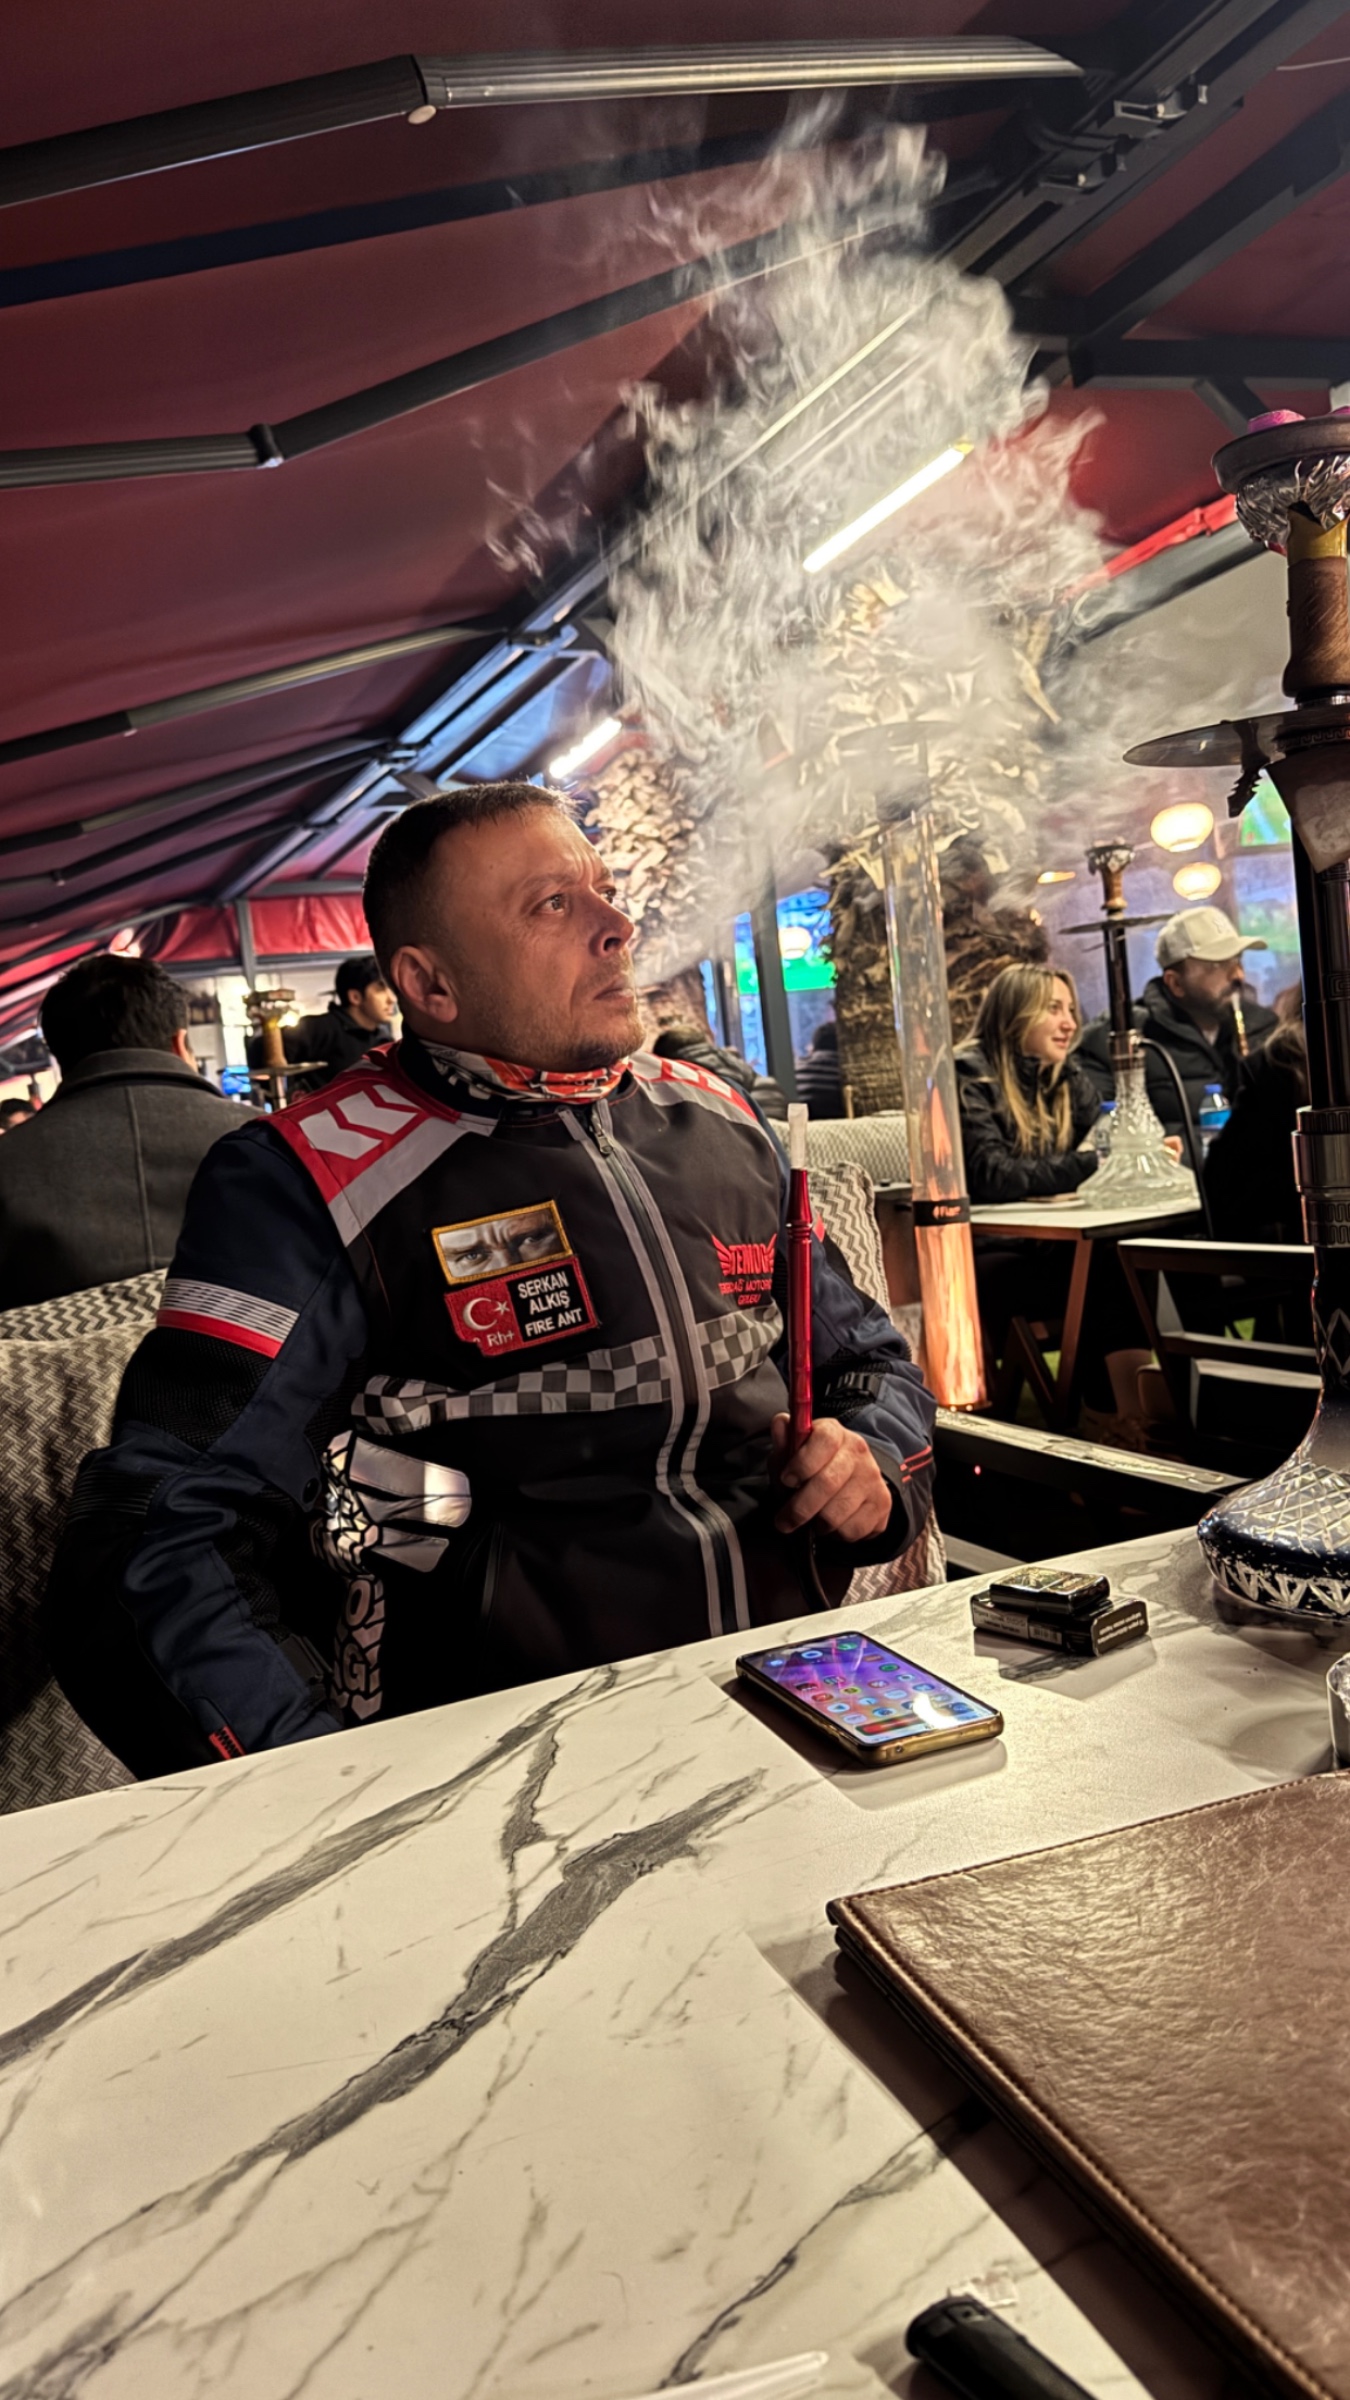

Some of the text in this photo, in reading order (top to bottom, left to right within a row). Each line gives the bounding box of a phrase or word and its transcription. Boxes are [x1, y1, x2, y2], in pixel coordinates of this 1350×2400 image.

[518, 1271, 569, 1299] SERKAN
[530, 1290, 571, 1315] ALKIŞ
[525, 1308, 582, 1337] FIRE ANT
[487, 1331, 515, 1347] Rh+
